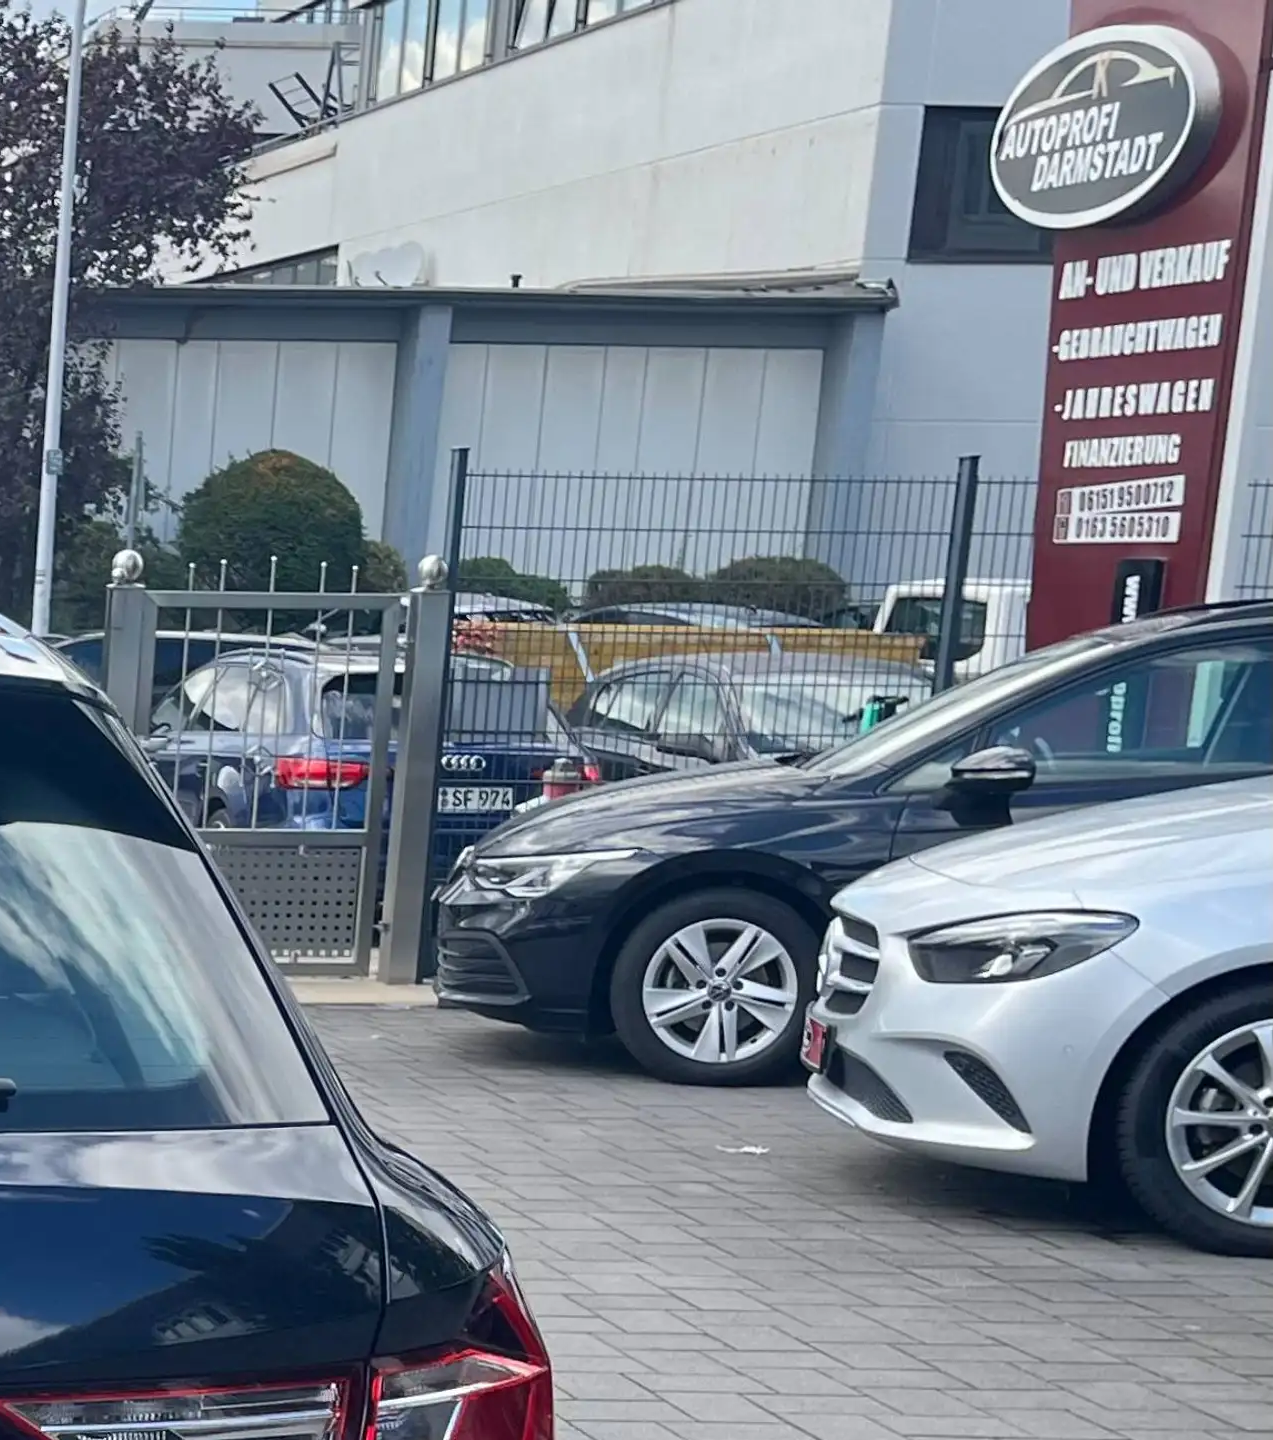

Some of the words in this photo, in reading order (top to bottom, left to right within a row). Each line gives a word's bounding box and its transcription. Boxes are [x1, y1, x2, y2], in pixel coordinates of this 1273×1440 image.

[1000, 101, 1121, 161] AUTOPROFI
[1030, 132, 1164, 192] DARMSTADT
[1094, 253, 1138, 296] UND
[1139, 239, 1232, 290] VERKAUF
[1063, 433, 1182, 468] FINANZIERUNG
[452, 789, 473, 807] SF
